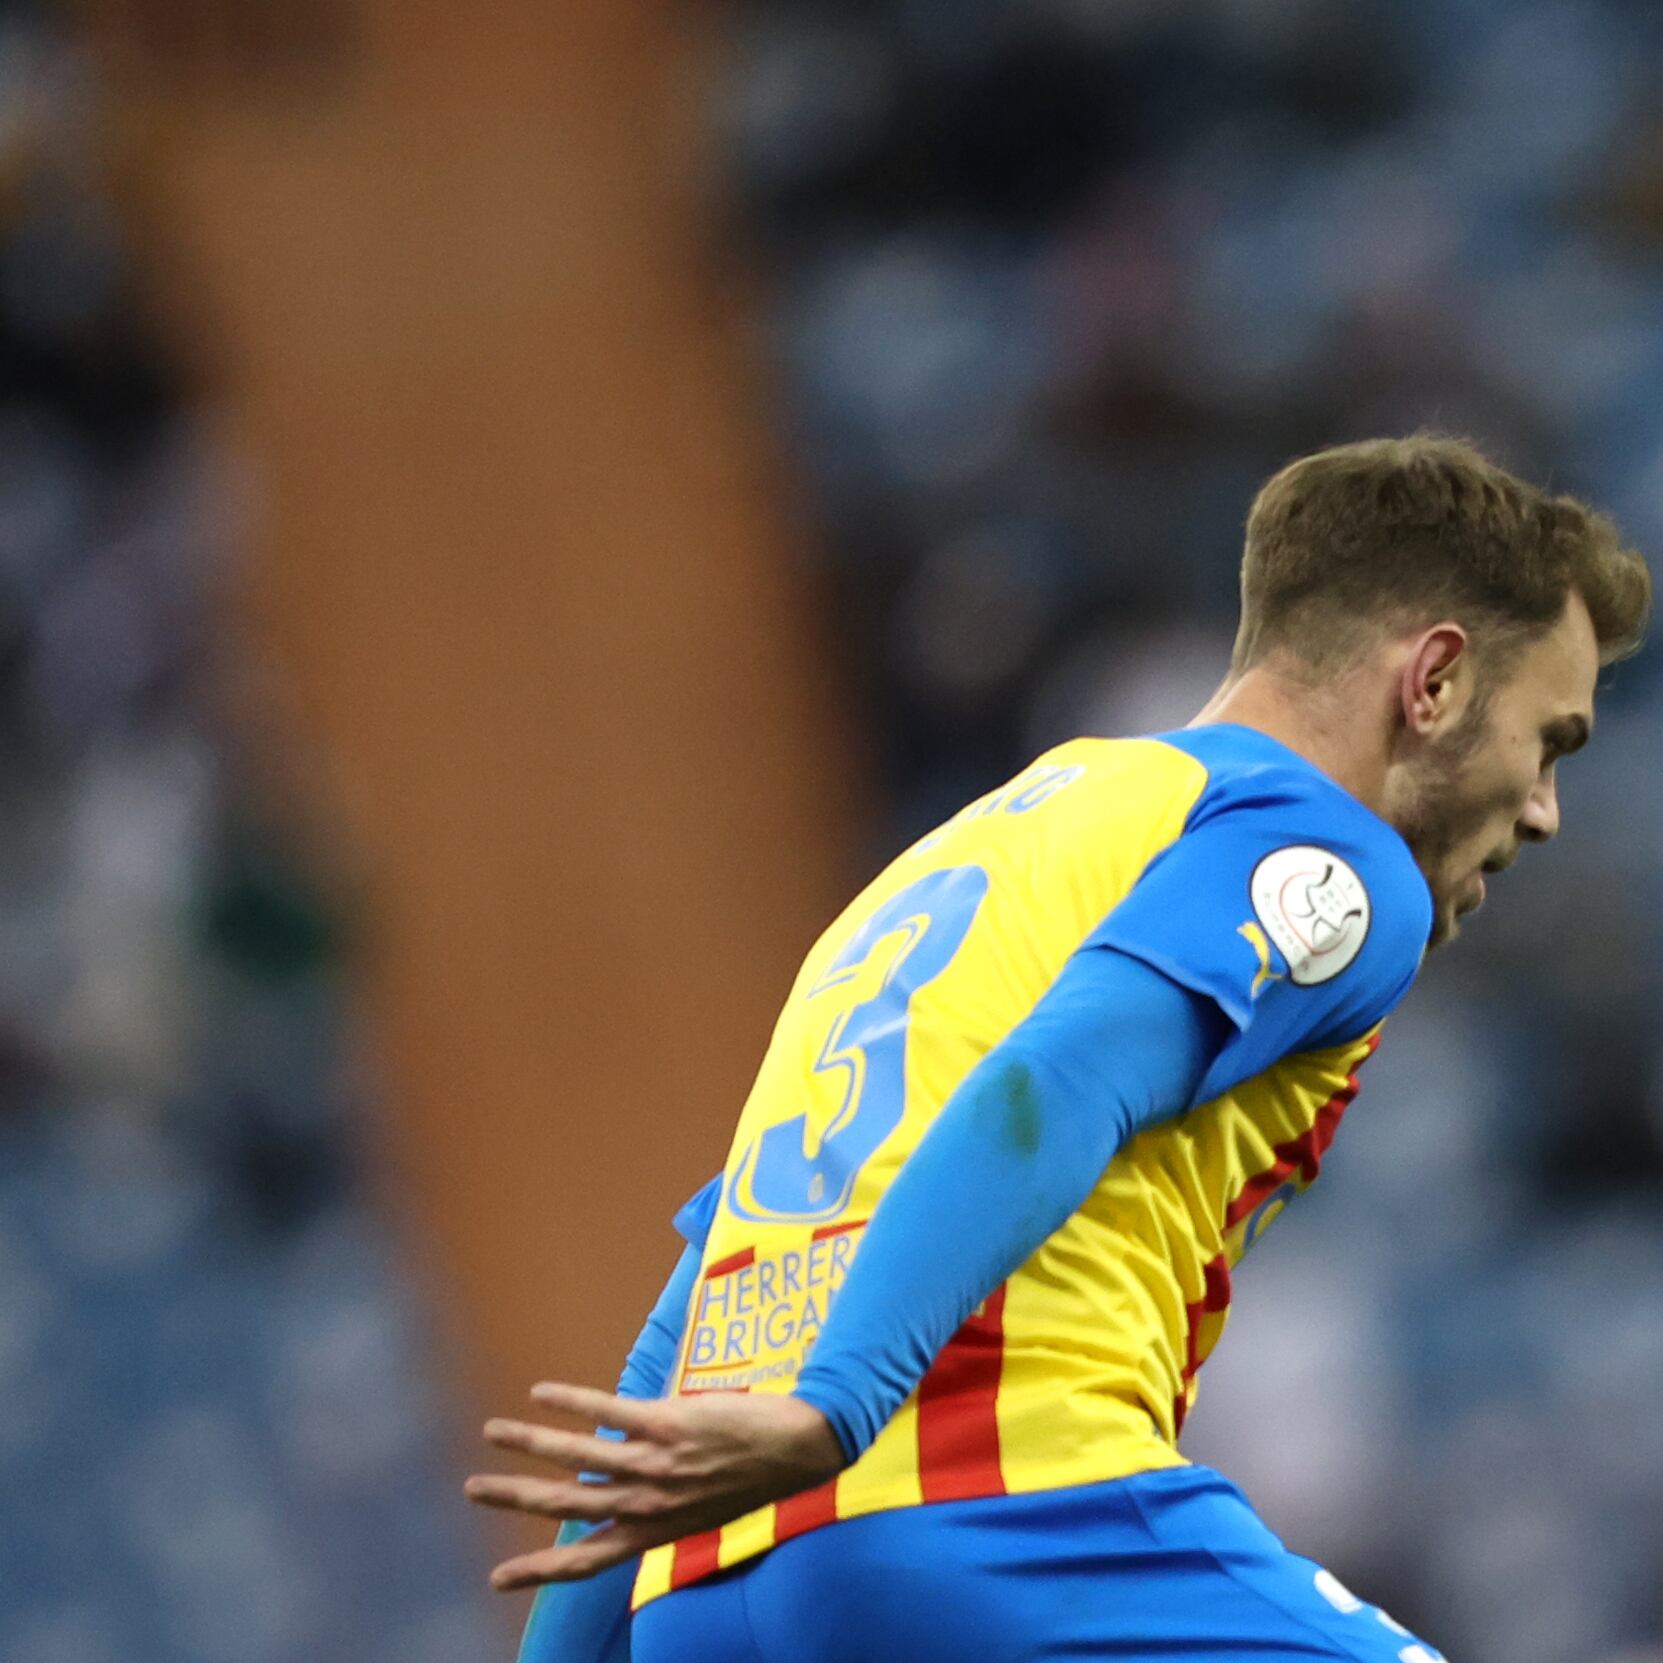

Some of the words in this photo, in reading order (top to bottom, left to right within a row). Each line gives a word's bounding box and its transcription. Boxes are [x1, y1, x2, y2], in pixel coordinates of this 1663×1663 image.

[729, 863, 989, 1223] 3
[701, 1235, 852, 1321] HERRER
[691, 1286, 838, 1365] BRIGA
